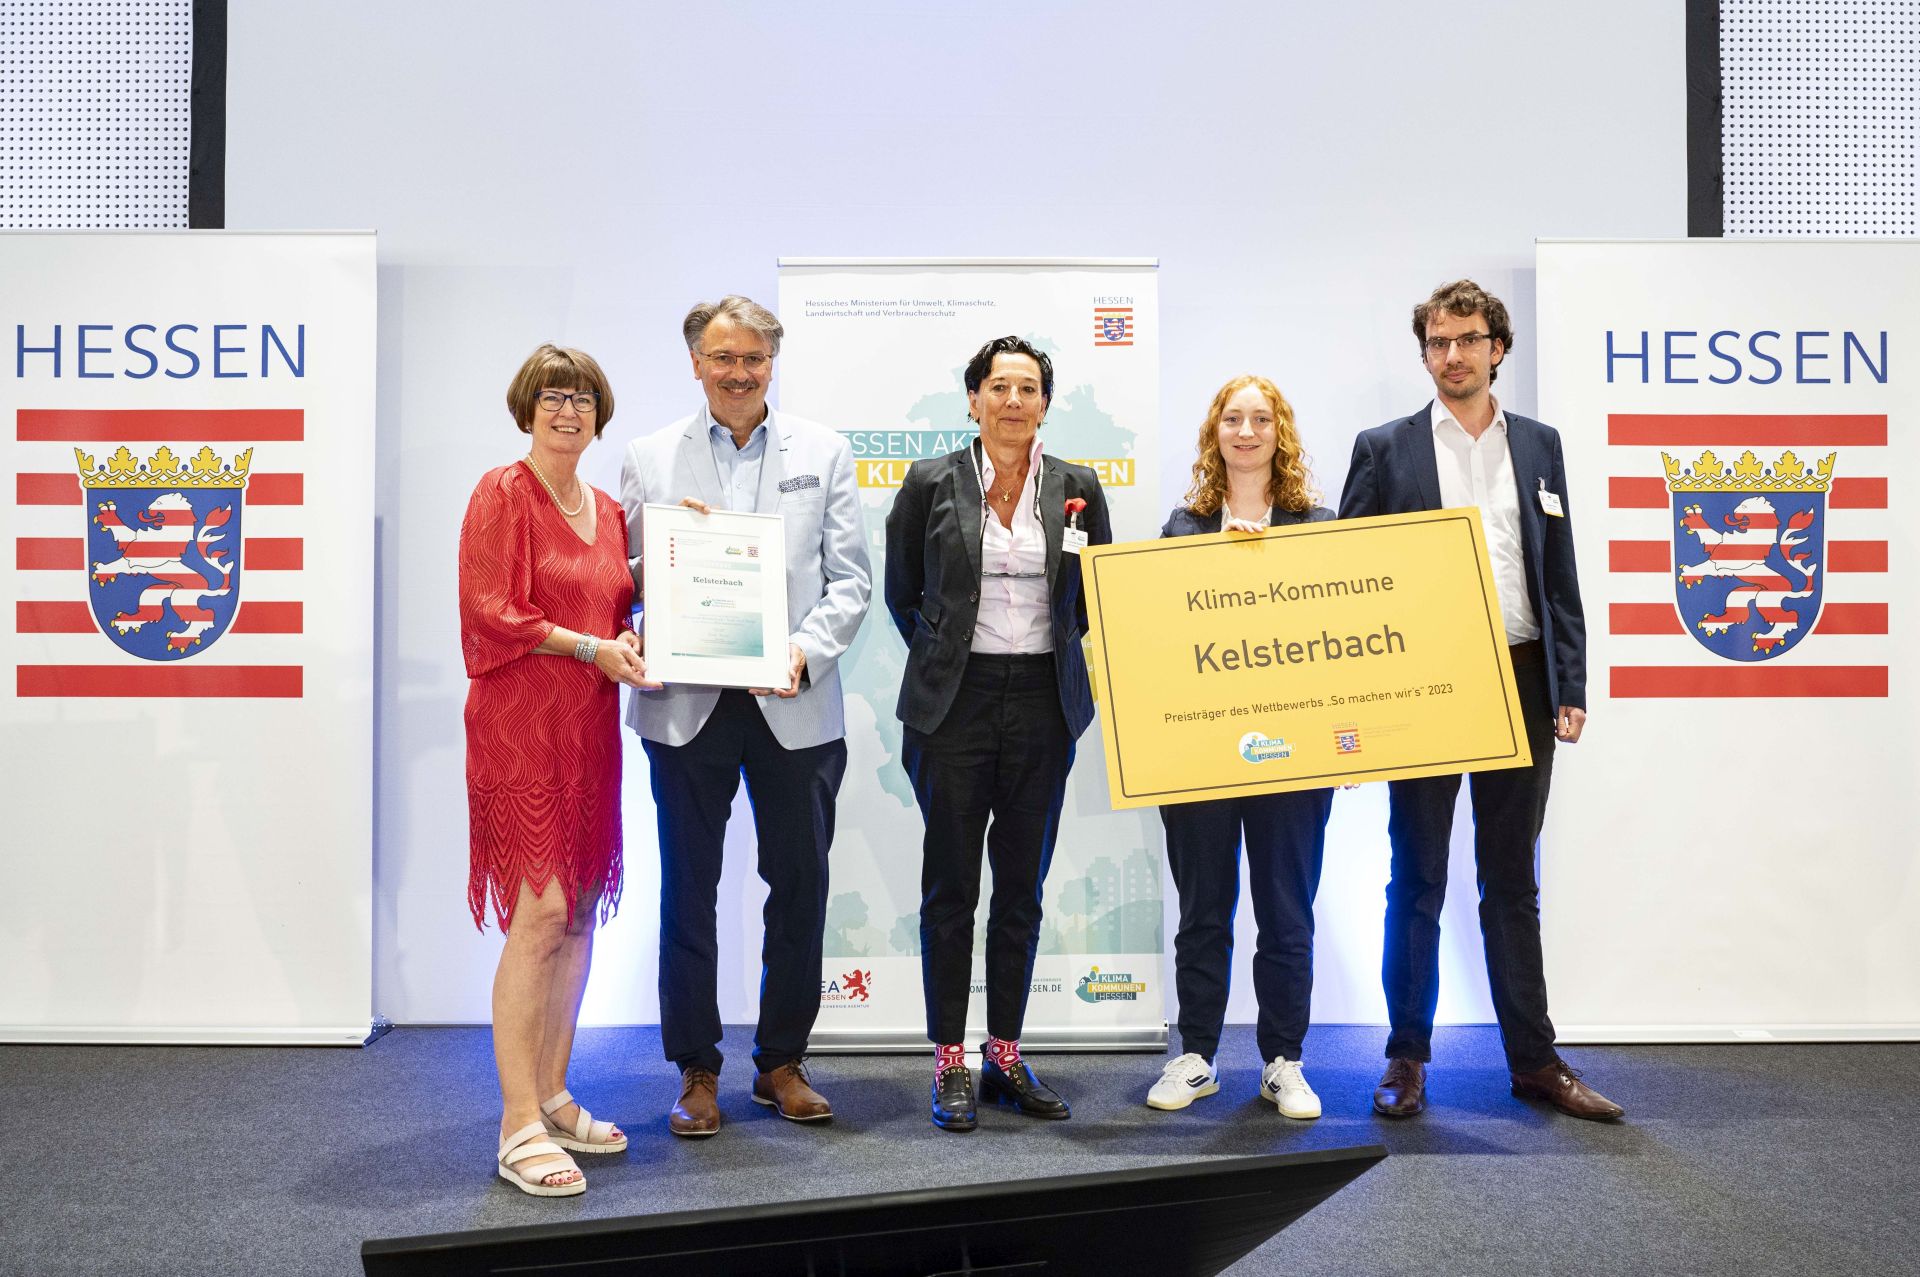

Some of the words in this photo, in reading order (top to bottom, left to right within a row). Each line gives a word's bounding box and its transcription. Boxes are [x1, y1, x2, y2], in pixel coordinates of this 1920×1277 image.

[805, 299, 849, 307] Hessisches
[850, 299, 898, 307] Ministerium
[899, 299, 911, 307] für
[912, 299, 945, 308] Umwelt,
[1093, 296, 1134, 304] HESSEN
[805, 309, 864, 317] Landwirtschaft
[883, 309, 957, 317] Verbraucherschutz
[17, 324, 305, 379] HESSEN
[1606, 330, 1888, 385] HESSEN
[843, 431, 923, 456] SSEN
[693, 576, 743, 586] Kelsterbach
[1186, 576, 1394, 612] Klima-Kommune
[1194, 624, 1406, 674] Kelsterbach
[1164, 709, 1227, 723] Preisträger
[1230, 706, 1250, 717] des
[1251, 698, 1324, 714] Wettbewerbs
[1348, 691, 1392, 704] machen
[1428, 683, 1454, 696] 2023
[1101, 975, 1129, 983] KLIMA
[1091, 984, 1142, 992] KOMMUNEN
[1100, 992, 1133, 1000] HESSEN
